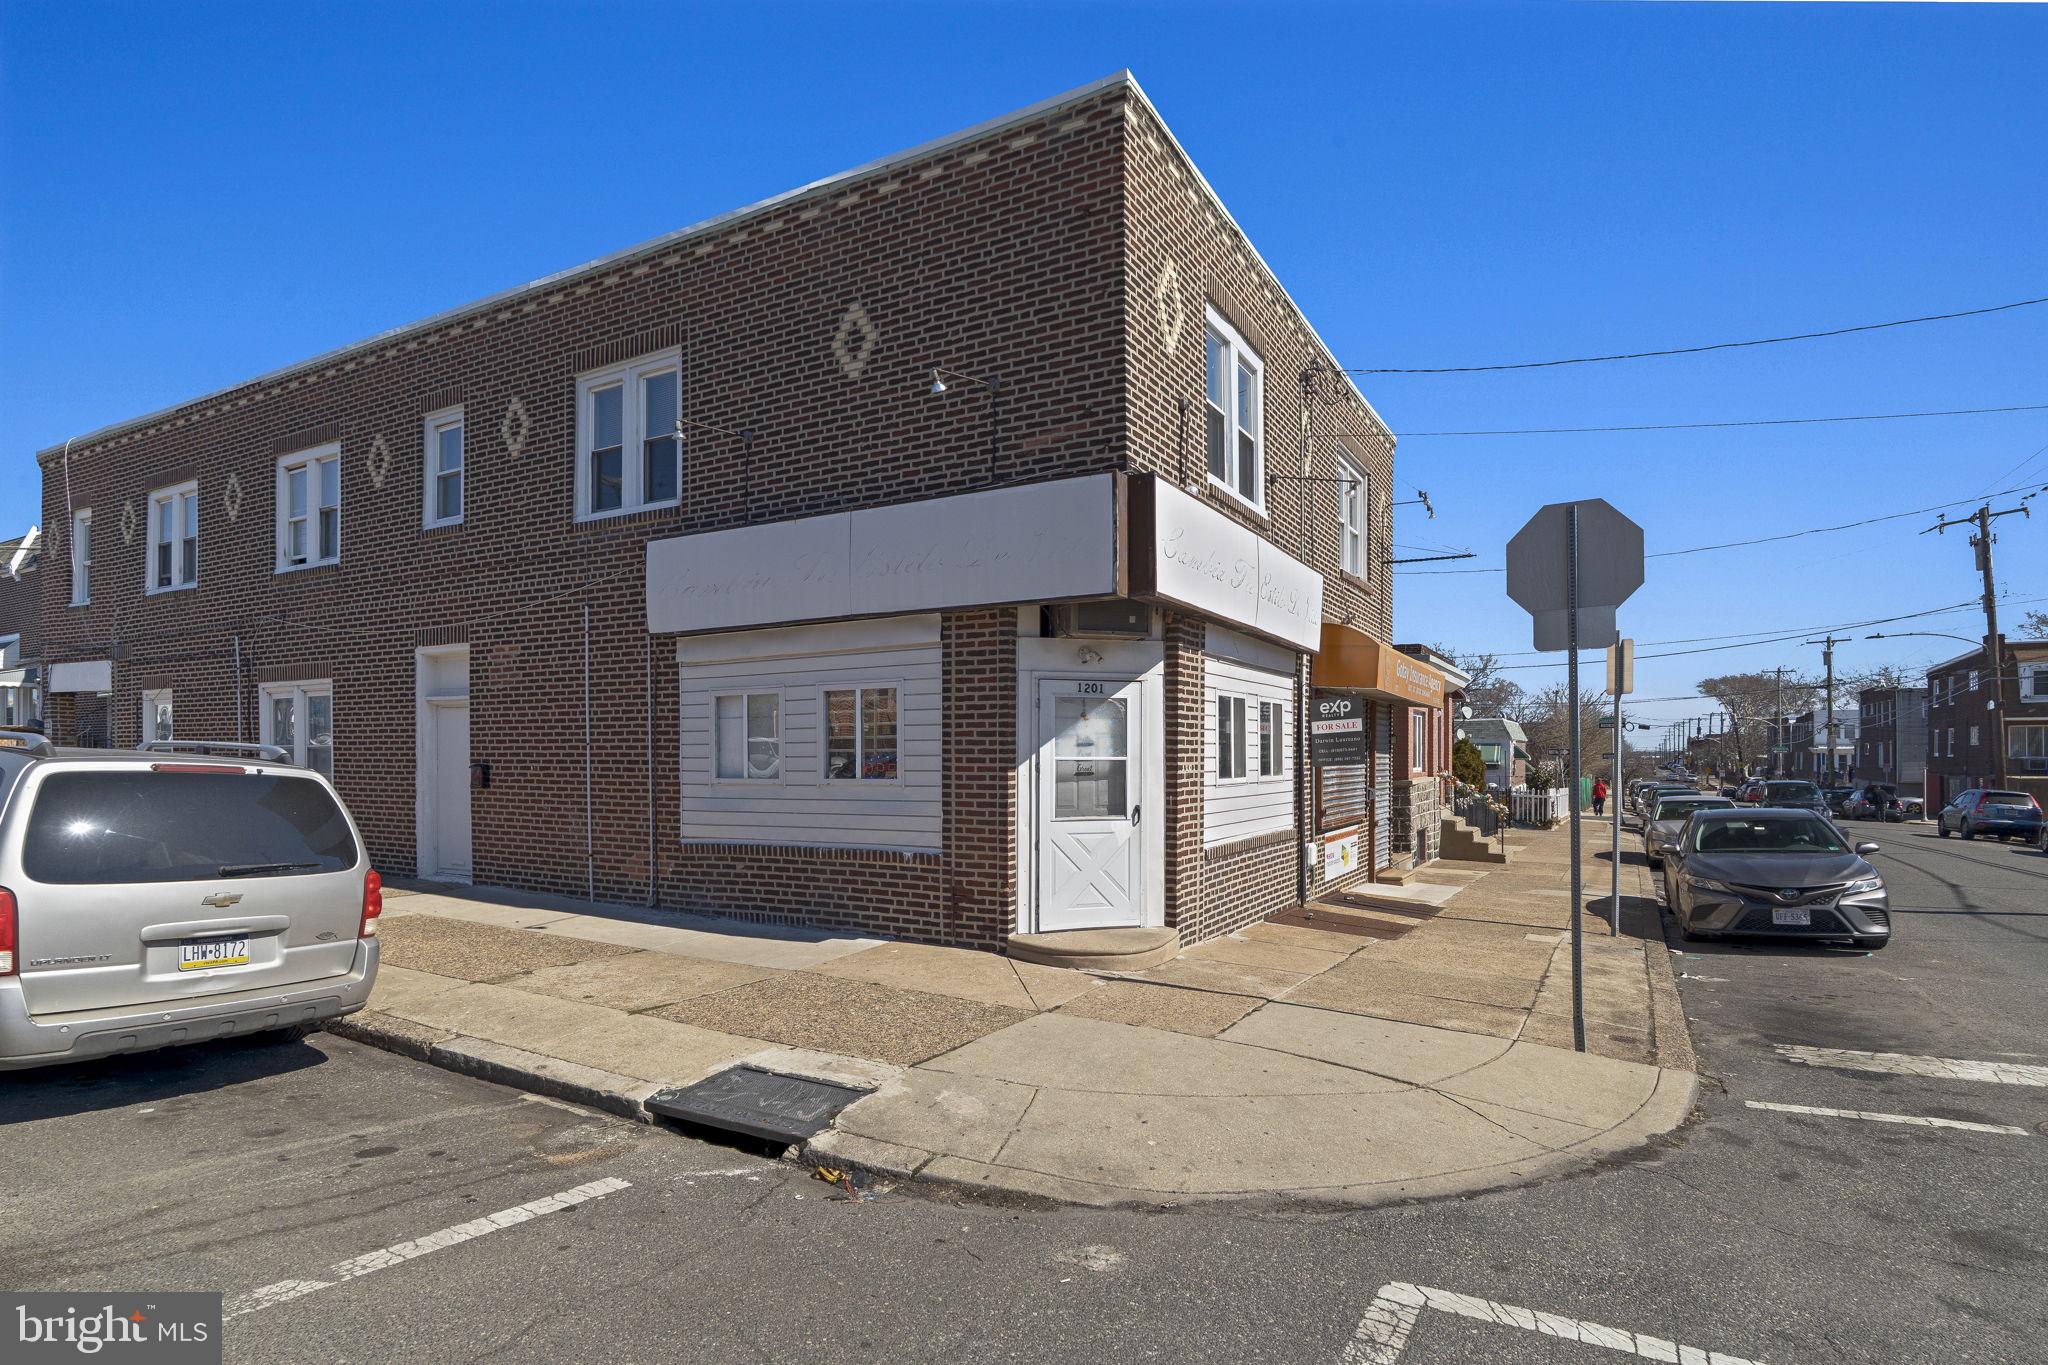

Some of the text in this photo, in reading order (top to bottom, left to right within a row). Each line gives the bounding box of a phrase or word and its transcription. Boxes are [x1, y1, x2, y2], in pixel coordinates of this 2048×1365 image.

[1077, 682, 1104, 694] 1201
[1316, 721, 1357, 731] FOR SALE
[30, 953, 113, 967] UPLANDER LT
